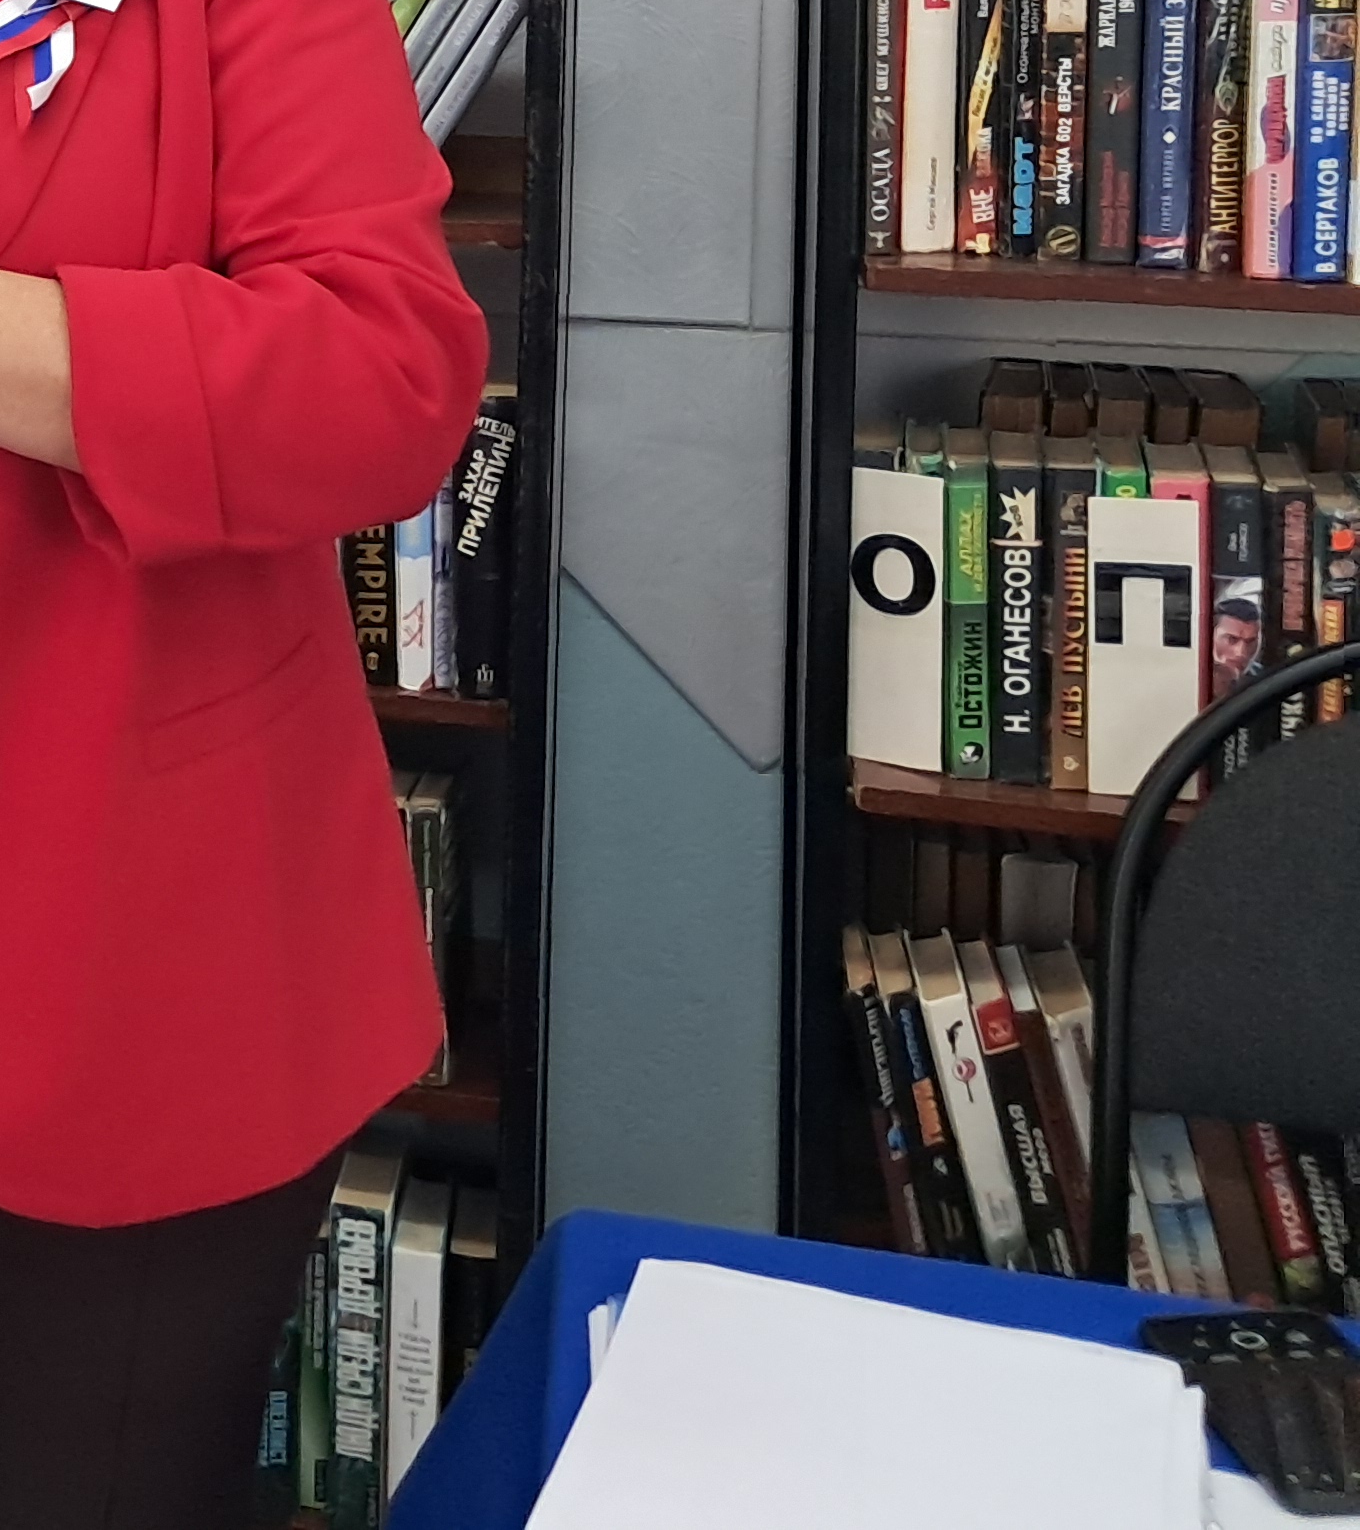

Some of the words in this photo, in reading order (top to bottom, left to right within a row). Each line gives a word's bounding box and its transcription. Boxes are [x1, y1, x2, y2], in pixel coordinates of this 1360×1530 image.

[1056, 57, 1074, 113] ВЕРСТЫ
[1156, 14, 1185, 112] КРАСНЫЙ
[1055, 118, 1073, 143] 602
[870, 148, 894, 222] ОСАДА
[969, 186, 995, 224] ВНЕ
[1054, 147, 1074, 206] ЗАГАДКА
[1209, 119, 1241, 234] АНТИТЕРРОР
[1313, 157, 1341, 256] СЕРТАКОВ
[473, 414, 517, 438] ИТЕЛЬ
[456, 433, 517, 559] ПРИЛЕПИН
[457, 447, 486, 504] ЗАХАР
[354, 523, 390, 647] EMPIRE
[851, 533, 937, 617] О
[1061, 546, 1086, 674] ПУСТЫНИ
[1094, 561, 1192, 649] П
[1002, 548, 1034, 697] ОГАНЕСОВ
[959, 621, 984, 730] Остожин
[1061, 685, 1085, 738] ЛЕВ
[1002, 709, 1032, 734] Н.
[336, 1217, 382, 1318] ДЕРЕВЬЕВ
[335, 1327, 381, 1395] СРЕДИ
